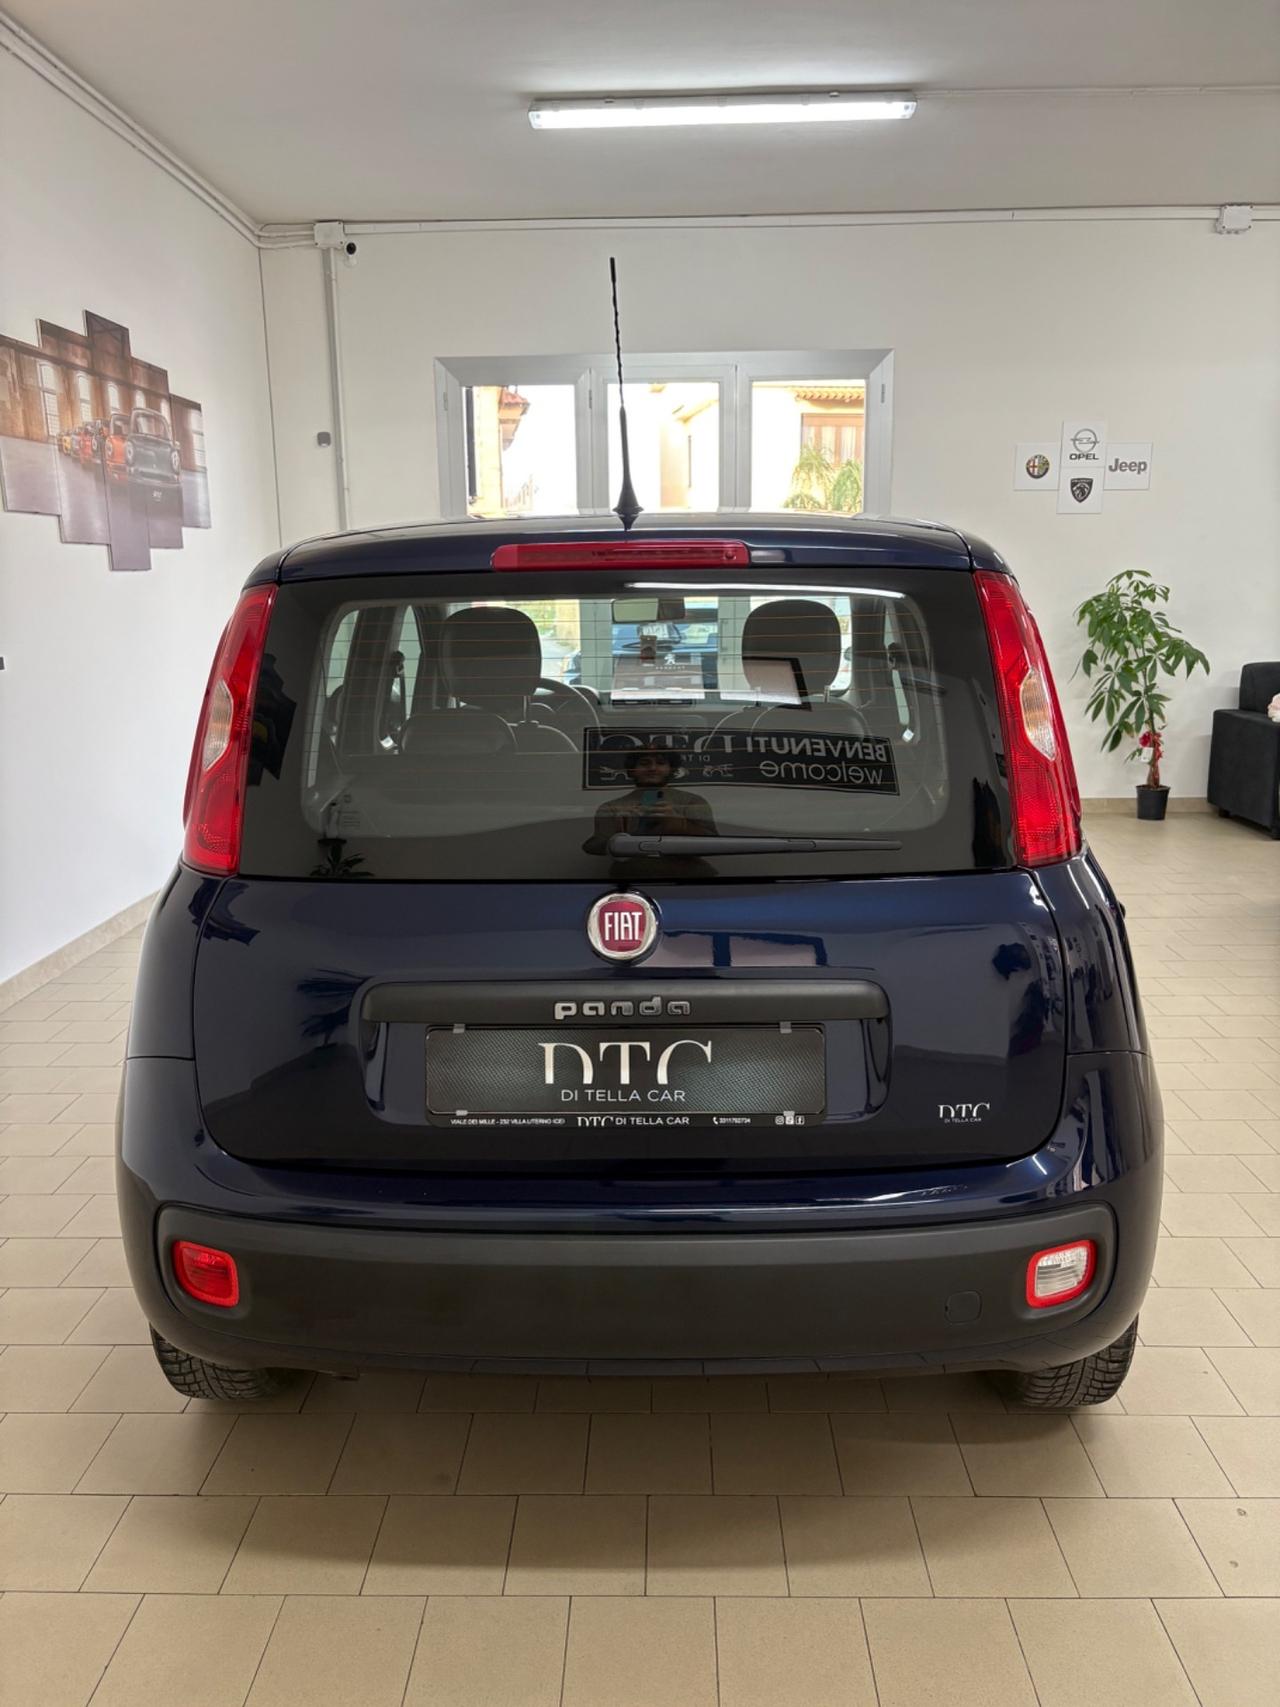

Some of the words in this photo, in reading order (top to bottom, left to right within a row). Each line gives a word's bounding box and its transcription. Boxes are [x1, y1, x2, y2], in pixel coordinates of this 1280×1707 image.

[1069, 453, 1099, 461] OPEL
[1108, 458, 1147, 475] Jeep
[604, 911, 643, 941] FIAT
[554, 996, 691, 1020] panda
[538, 1039, 712, 1085] DTC
[561, 1090, 578, 1101] DI
[585, 1090, 641, 1101] TELLA
[647, 1090, 686, 1101] CAR
[937, 1102, 990, 1118] DTC
[577, 1116, 614, 1127] DTC
[615, 1117, 626, 1125] DI
[629, 1117, 663, 1125] TELLA
[666, 1117, 690, 1125] CAR
